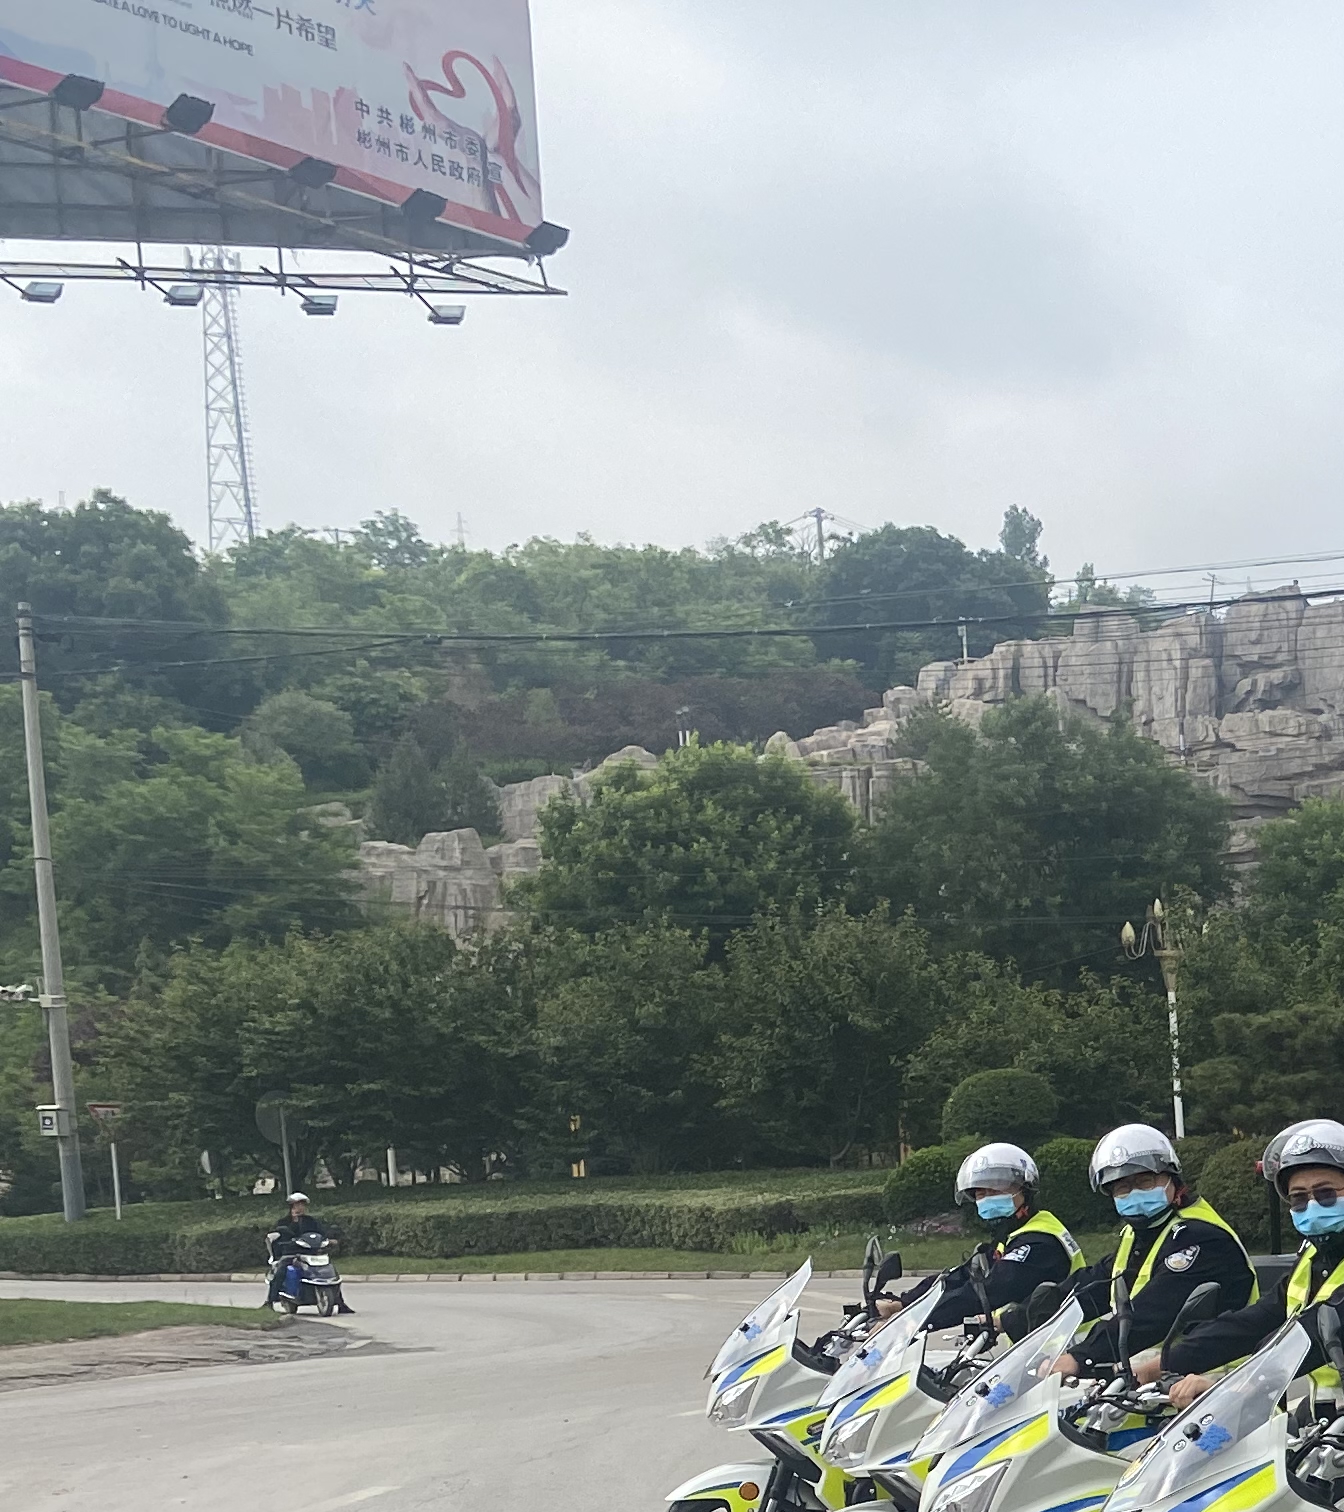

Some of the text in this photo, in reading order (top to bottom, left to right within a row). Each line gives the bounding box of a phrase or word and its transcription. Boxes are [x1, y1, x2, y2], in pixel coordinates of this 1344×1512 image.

[132, 4, 160, 24] LOVE
[162, 14, 178, 29] TO
[180, 20, 211, 40] LIGHT
[213, 32, 222, 45] A
[223, 36, 254, 57] HOPE
